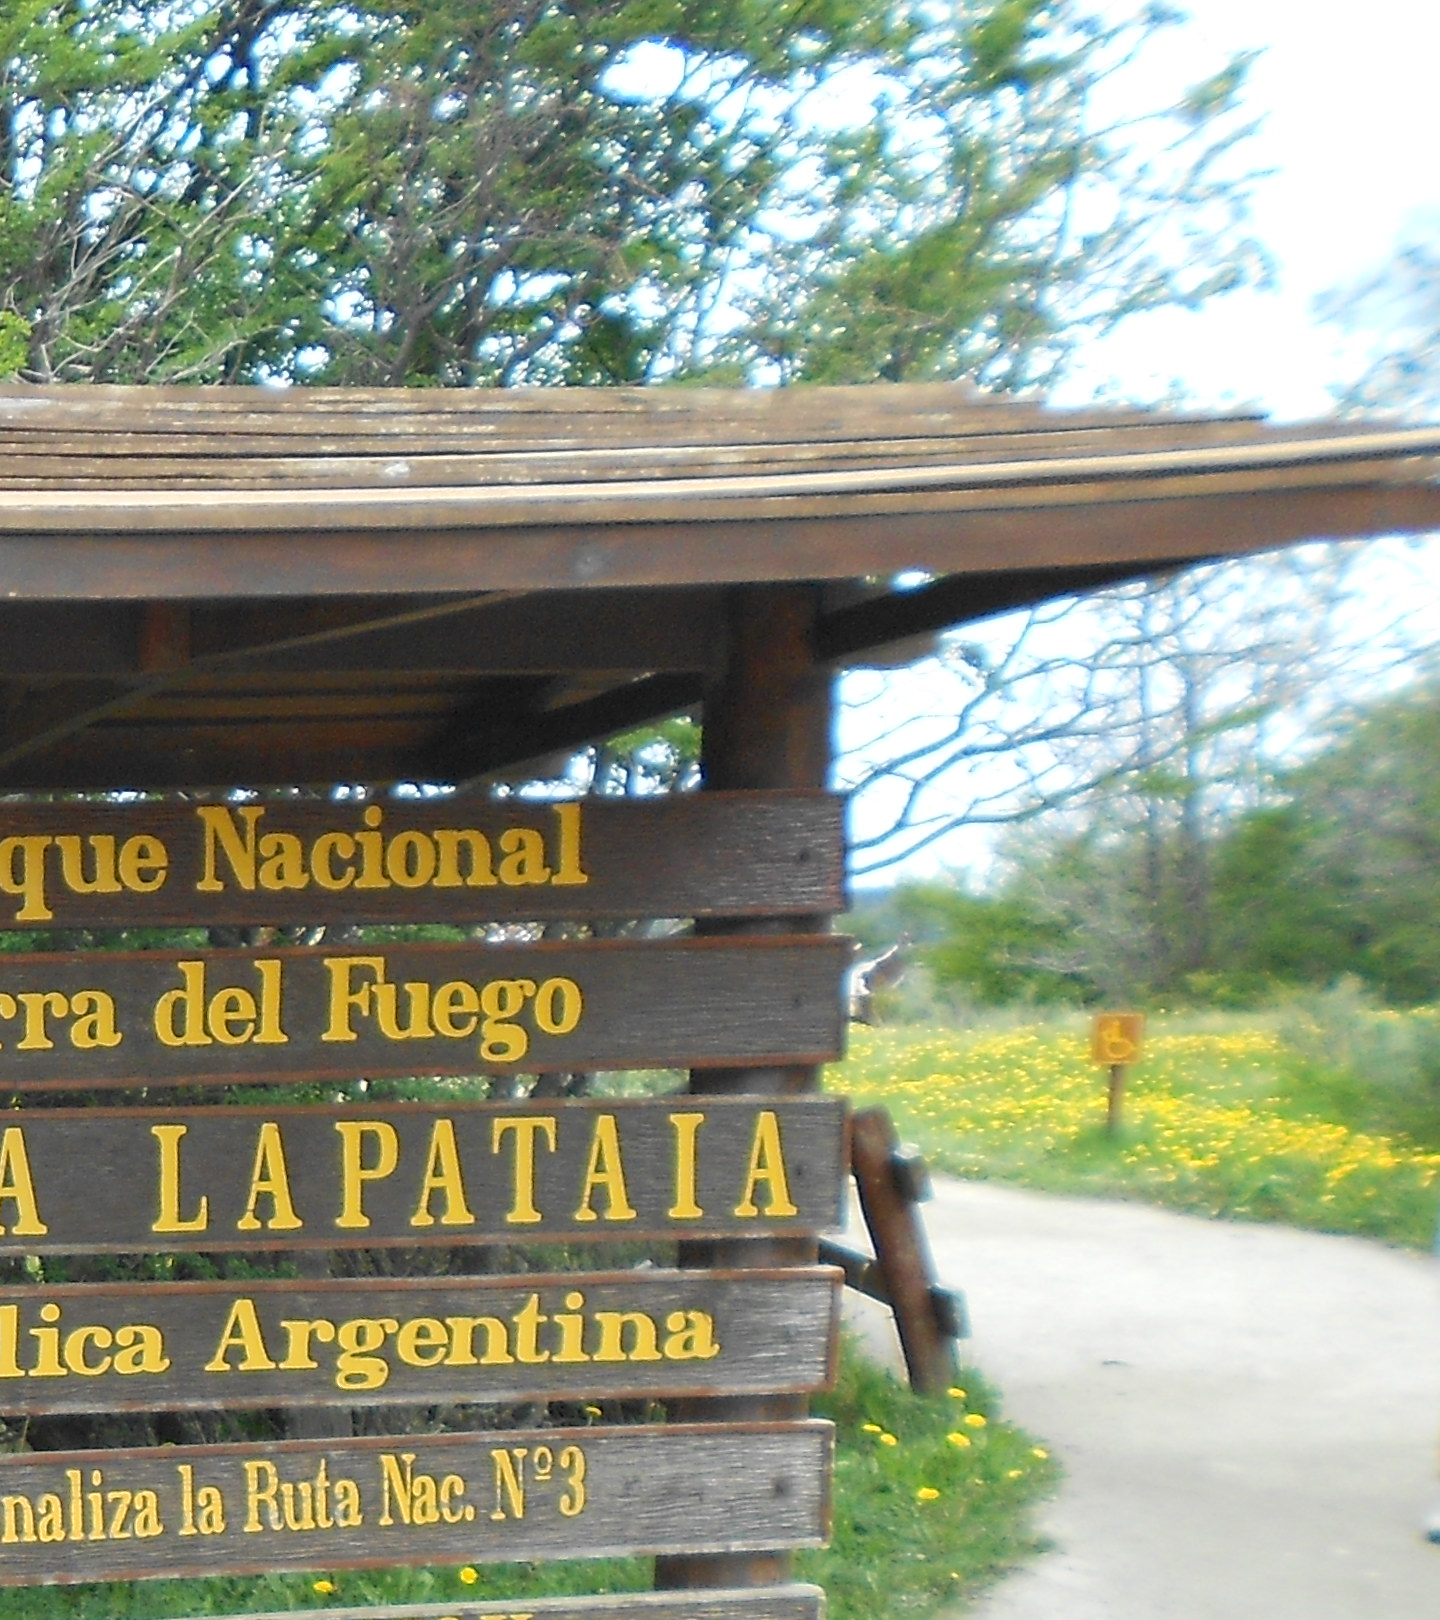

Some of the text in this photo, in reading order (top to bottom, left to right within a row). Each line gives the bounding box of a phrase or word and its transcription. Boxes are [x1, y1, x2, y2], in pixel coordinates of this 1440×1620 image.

[197, 804, 588, 892] Nacional
[154, 961, 285, 1045] del
[324, 957, 582, 1063] Fuego
[152, 1112, 798, 1232] LAPATAIA
[206, 1294, 720, 1390] Argentina
[180, 1464, 226, 1535] la
[244, 1458, 362, 1533] Ruta
[380, 1452, 475, 1527] Nac.
